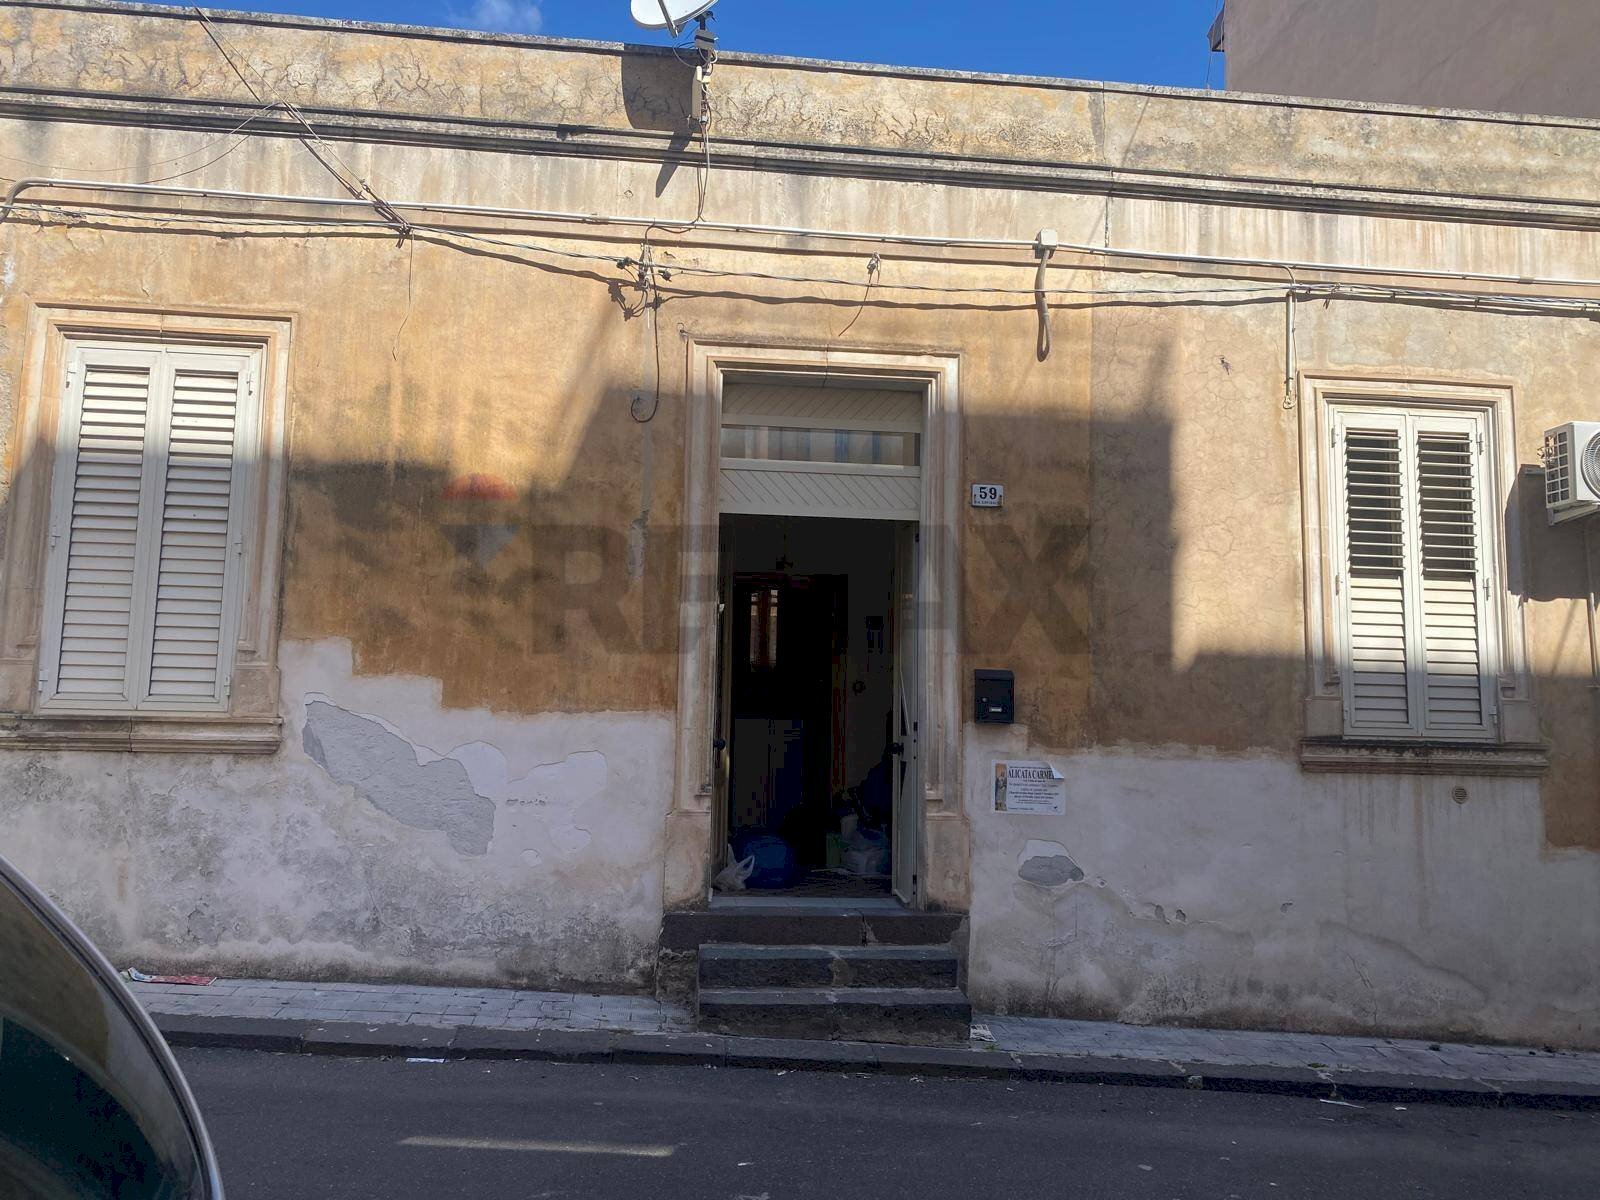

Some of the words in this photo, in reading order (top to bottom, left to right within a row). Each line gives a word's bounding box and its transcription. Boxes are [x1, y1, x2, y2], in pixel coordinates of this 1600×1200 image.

[979, 486, 997, 500] 59
[1007, 769, 1032, 779] ALICATA
[1032, 769, 1055, 780] CARME
